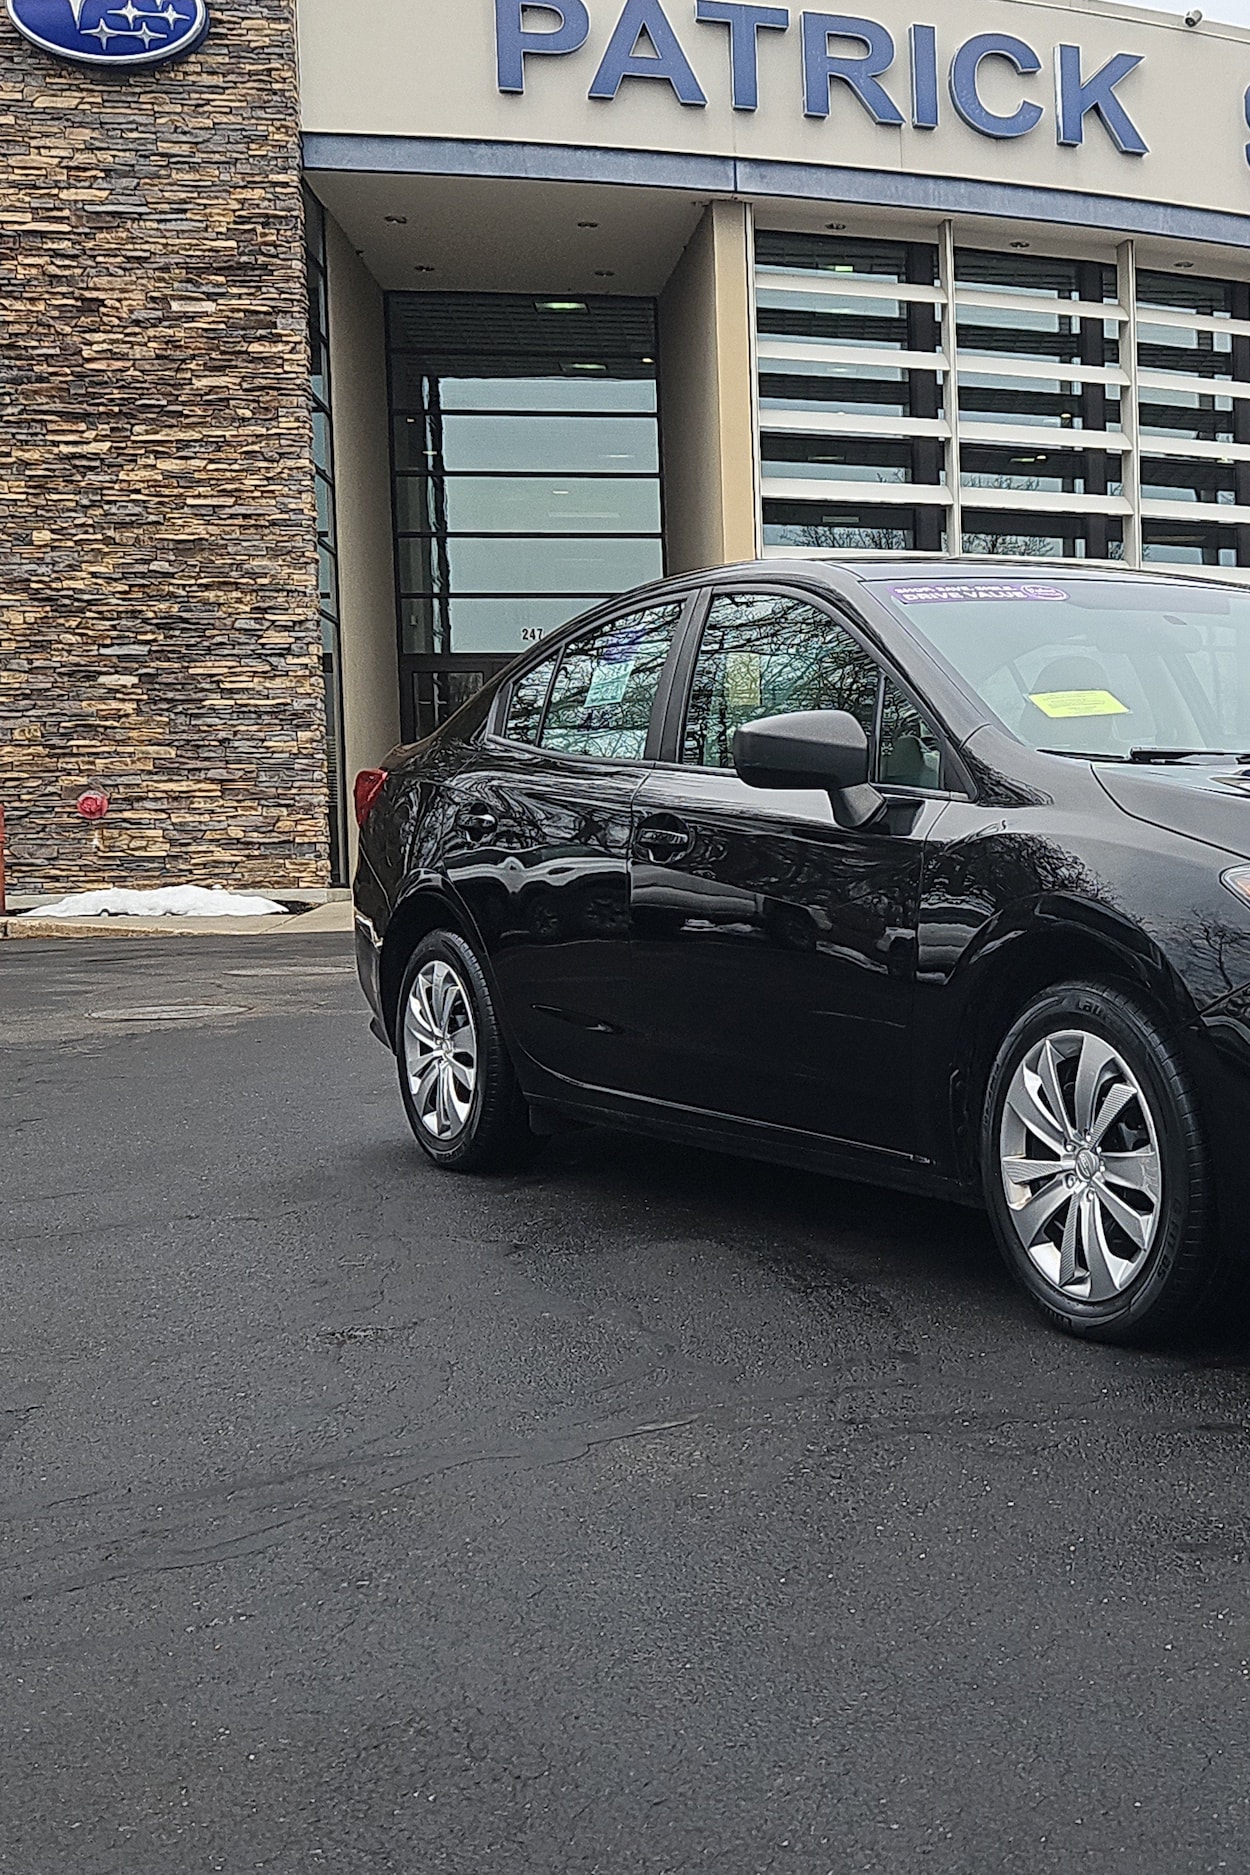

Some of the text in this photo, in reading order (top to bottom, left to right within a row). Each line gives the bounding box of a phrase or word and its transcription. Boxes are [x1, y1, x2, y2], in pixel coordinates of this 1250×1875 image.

[495, 0, 1150, 156] PATRICK
[902, 592, 964, 601] DRIVE
[963, 590, 1028, 599] VALUE
[522, 628, 543, 641] 247
